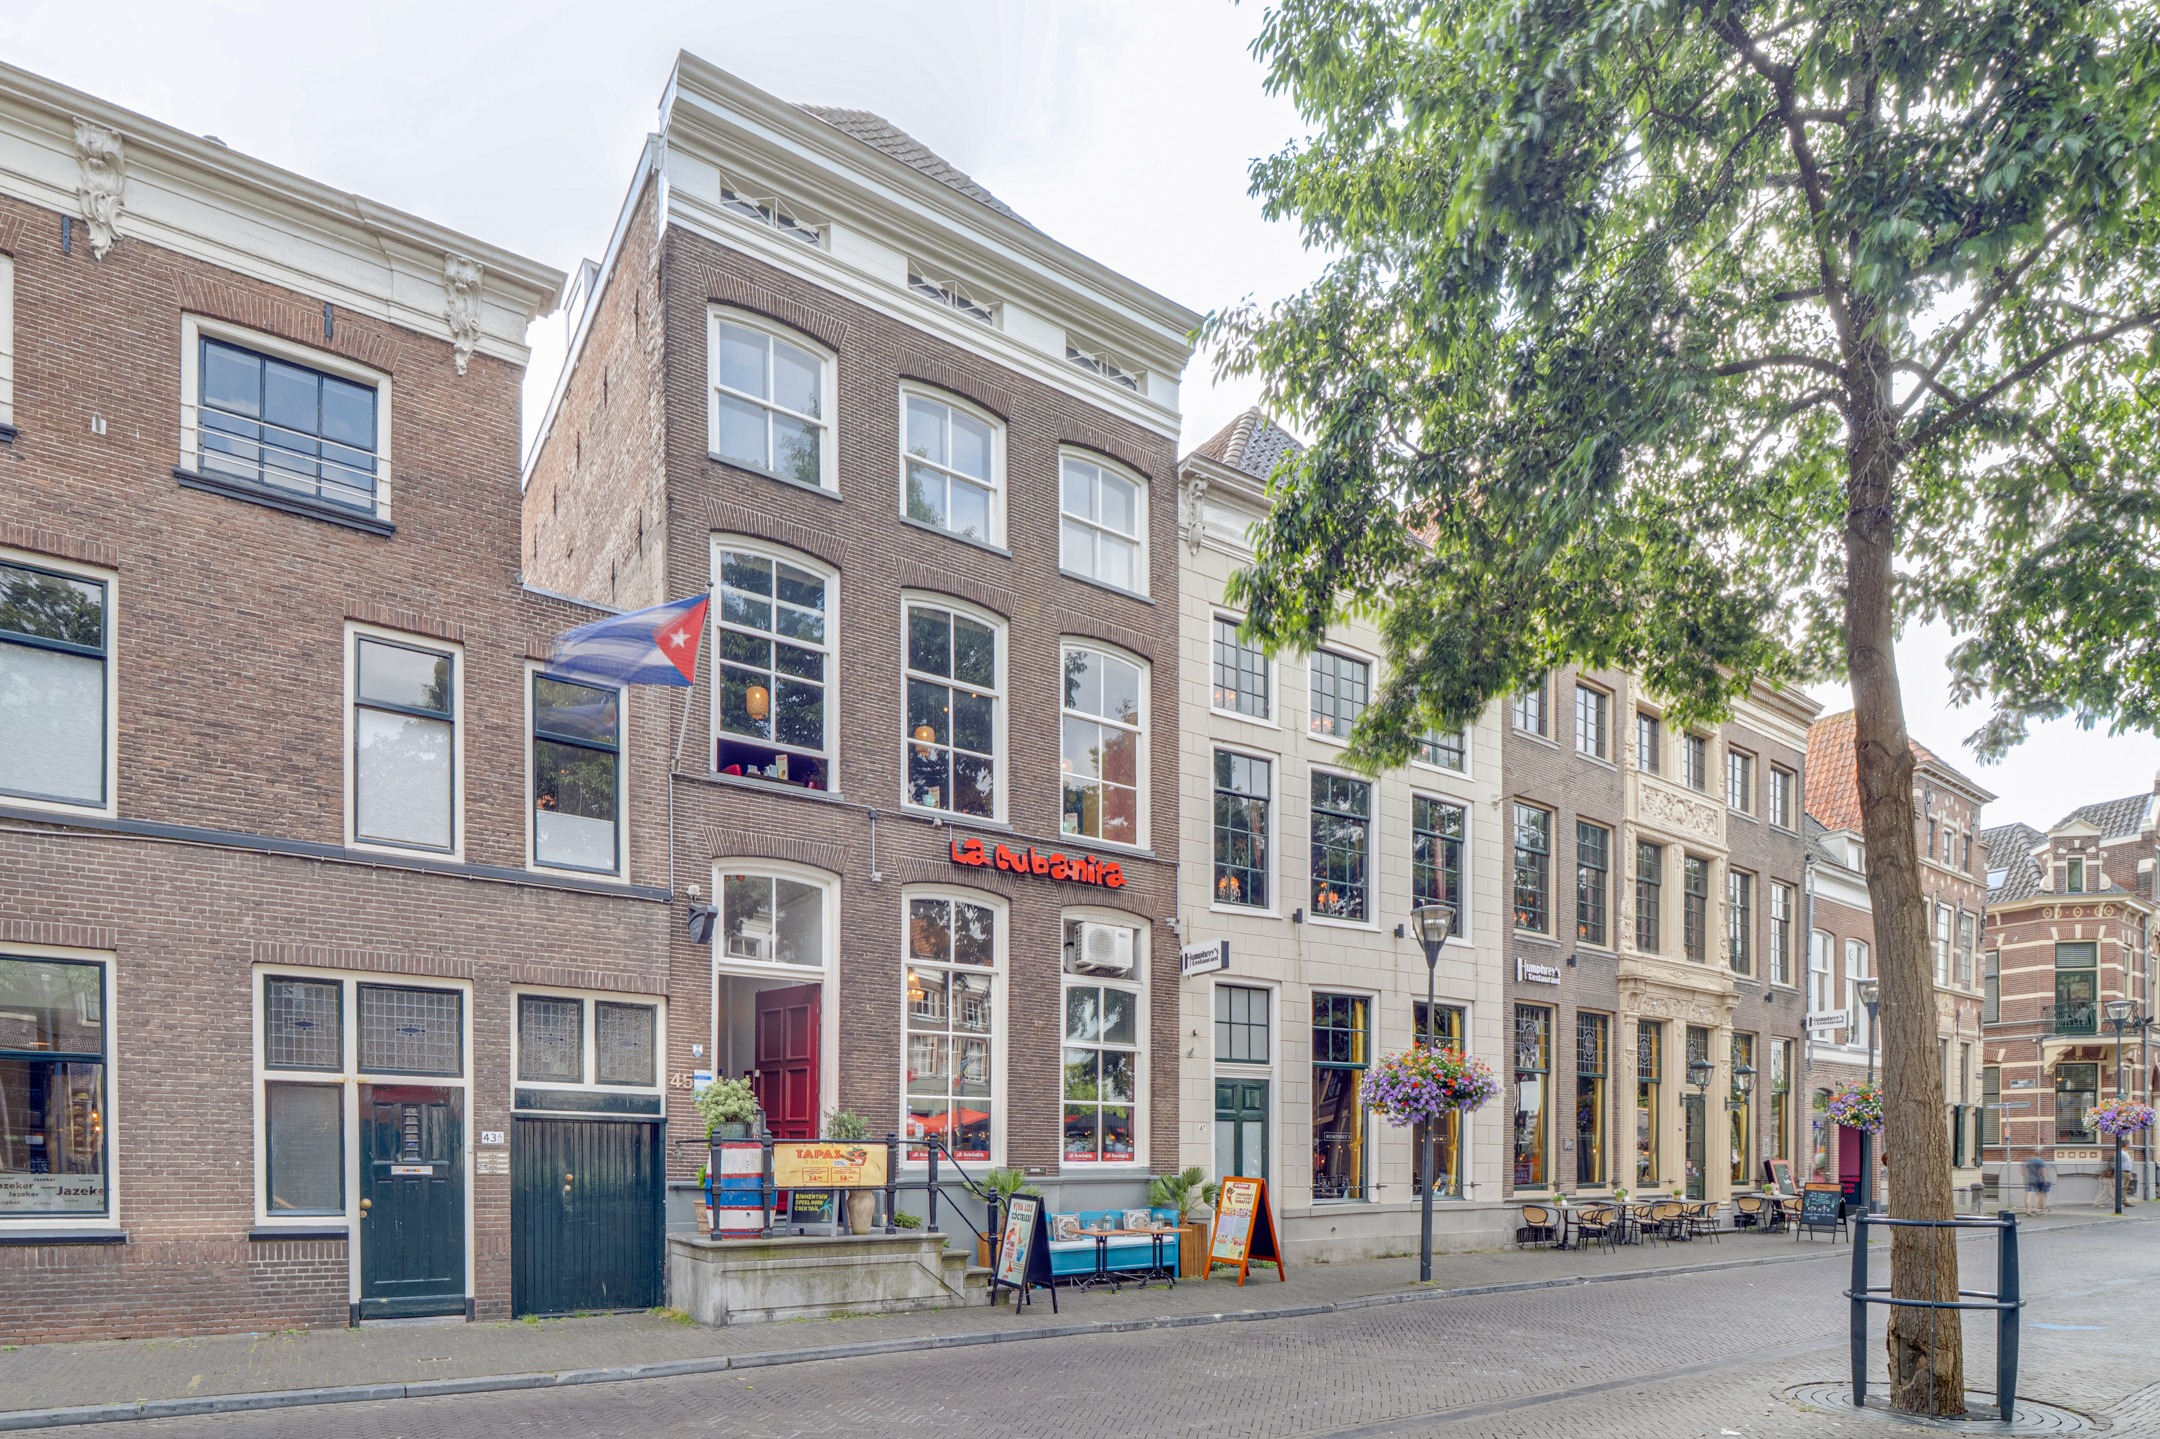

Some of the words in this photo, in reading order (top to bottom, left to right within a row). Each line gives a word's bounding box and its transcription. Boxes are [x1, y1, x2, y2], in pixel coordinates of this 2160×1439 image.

[1517, 957, 1561, 982] Humphrey's
[669, 1073, 694, 1090] 45
[796, 1150, 841, 1159] TAPAS
